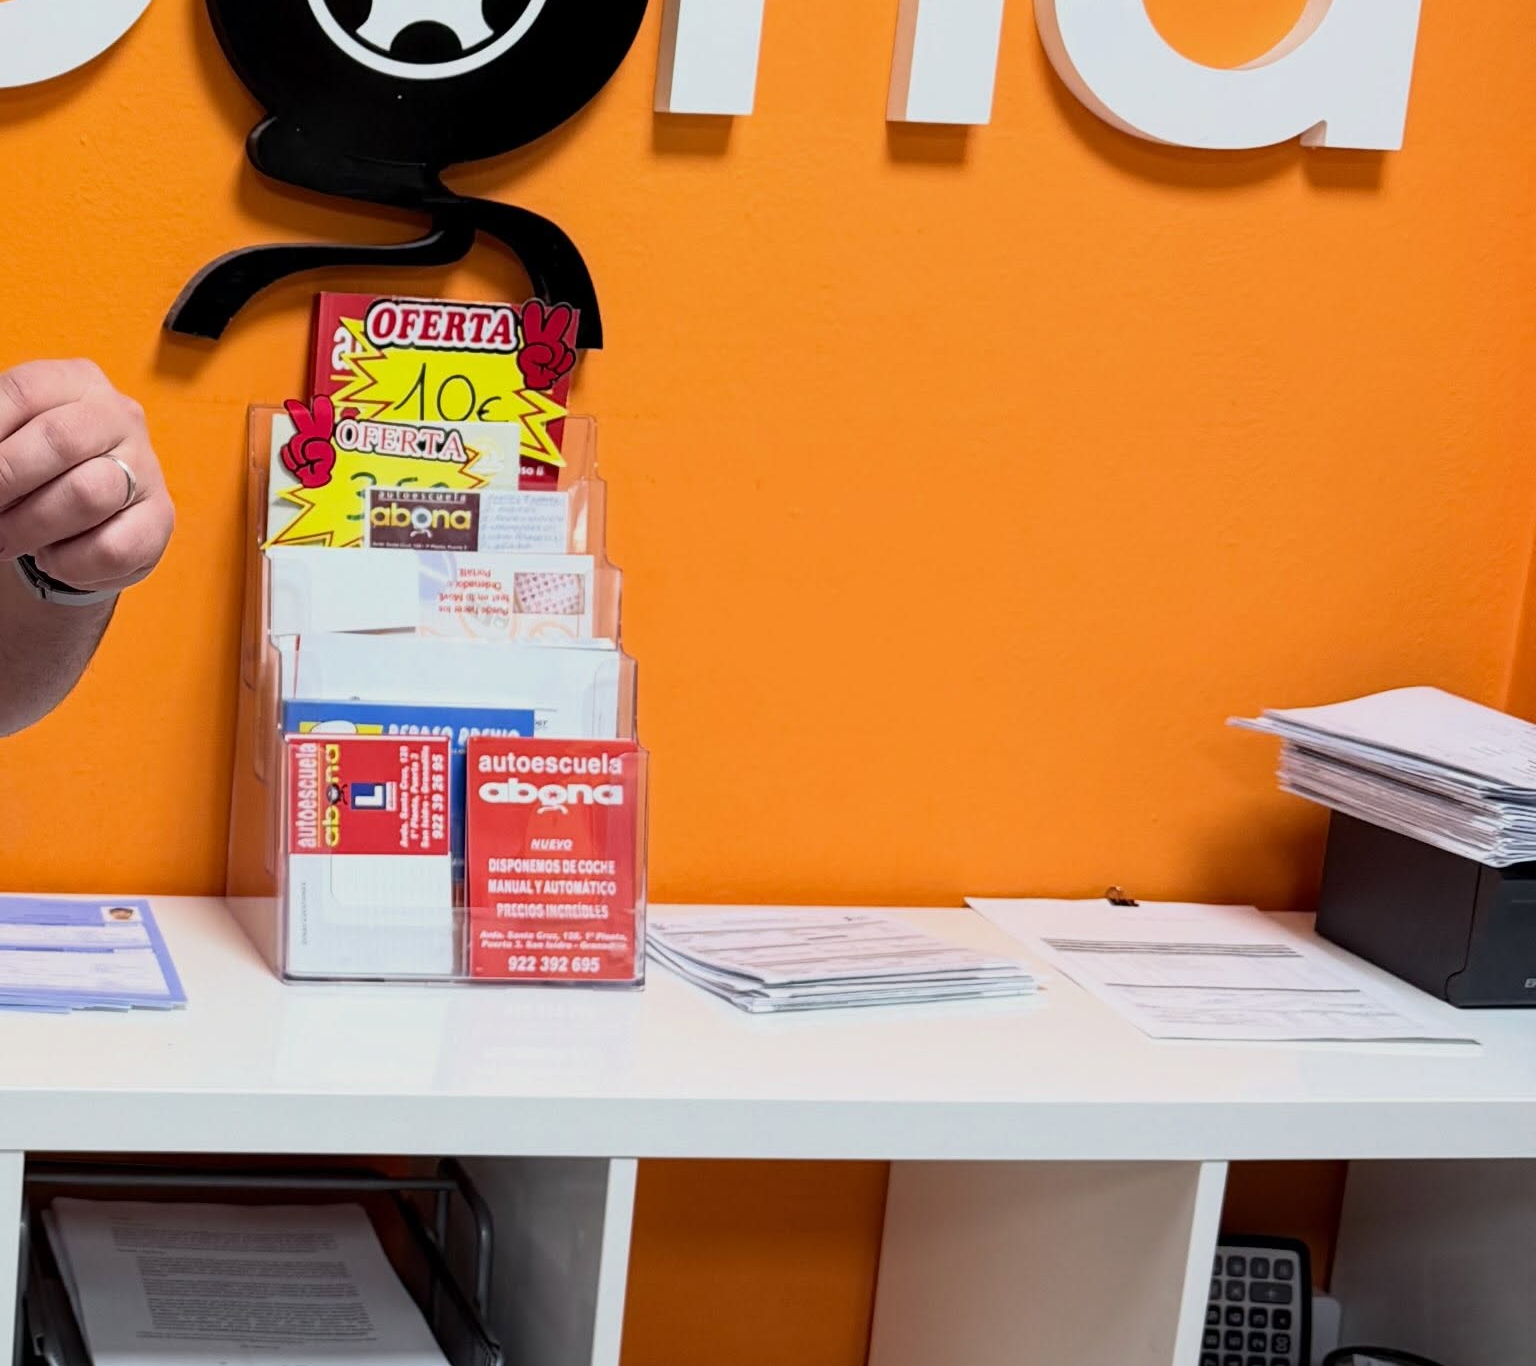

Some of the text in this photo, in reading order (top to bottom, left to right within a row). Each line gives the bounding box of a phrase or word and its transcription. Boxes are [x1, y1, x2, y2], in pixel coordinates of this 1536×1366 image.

[370, 306, 514, 346] OFERTA
[338, 421, 465, 461] OFERTA
[371, 502, 473, 531] abona
[478, 752, 624, 775] autoescuela
[295, 742, 318, 848] autoescuela
[322, 743, 341, 847] abona
[478, 777, 624, 806] abona
[530, 838, 574, 851] NUEVO
[488, 858, 616, 875] DISPONEMOS DE COCHE
[488, 878, 534, 895] MANUAL
[534, 879, 543, 894] Y
[496, 902, 544, 918] PRECIOS
[507, 955, 601, 973] 922 392 695
